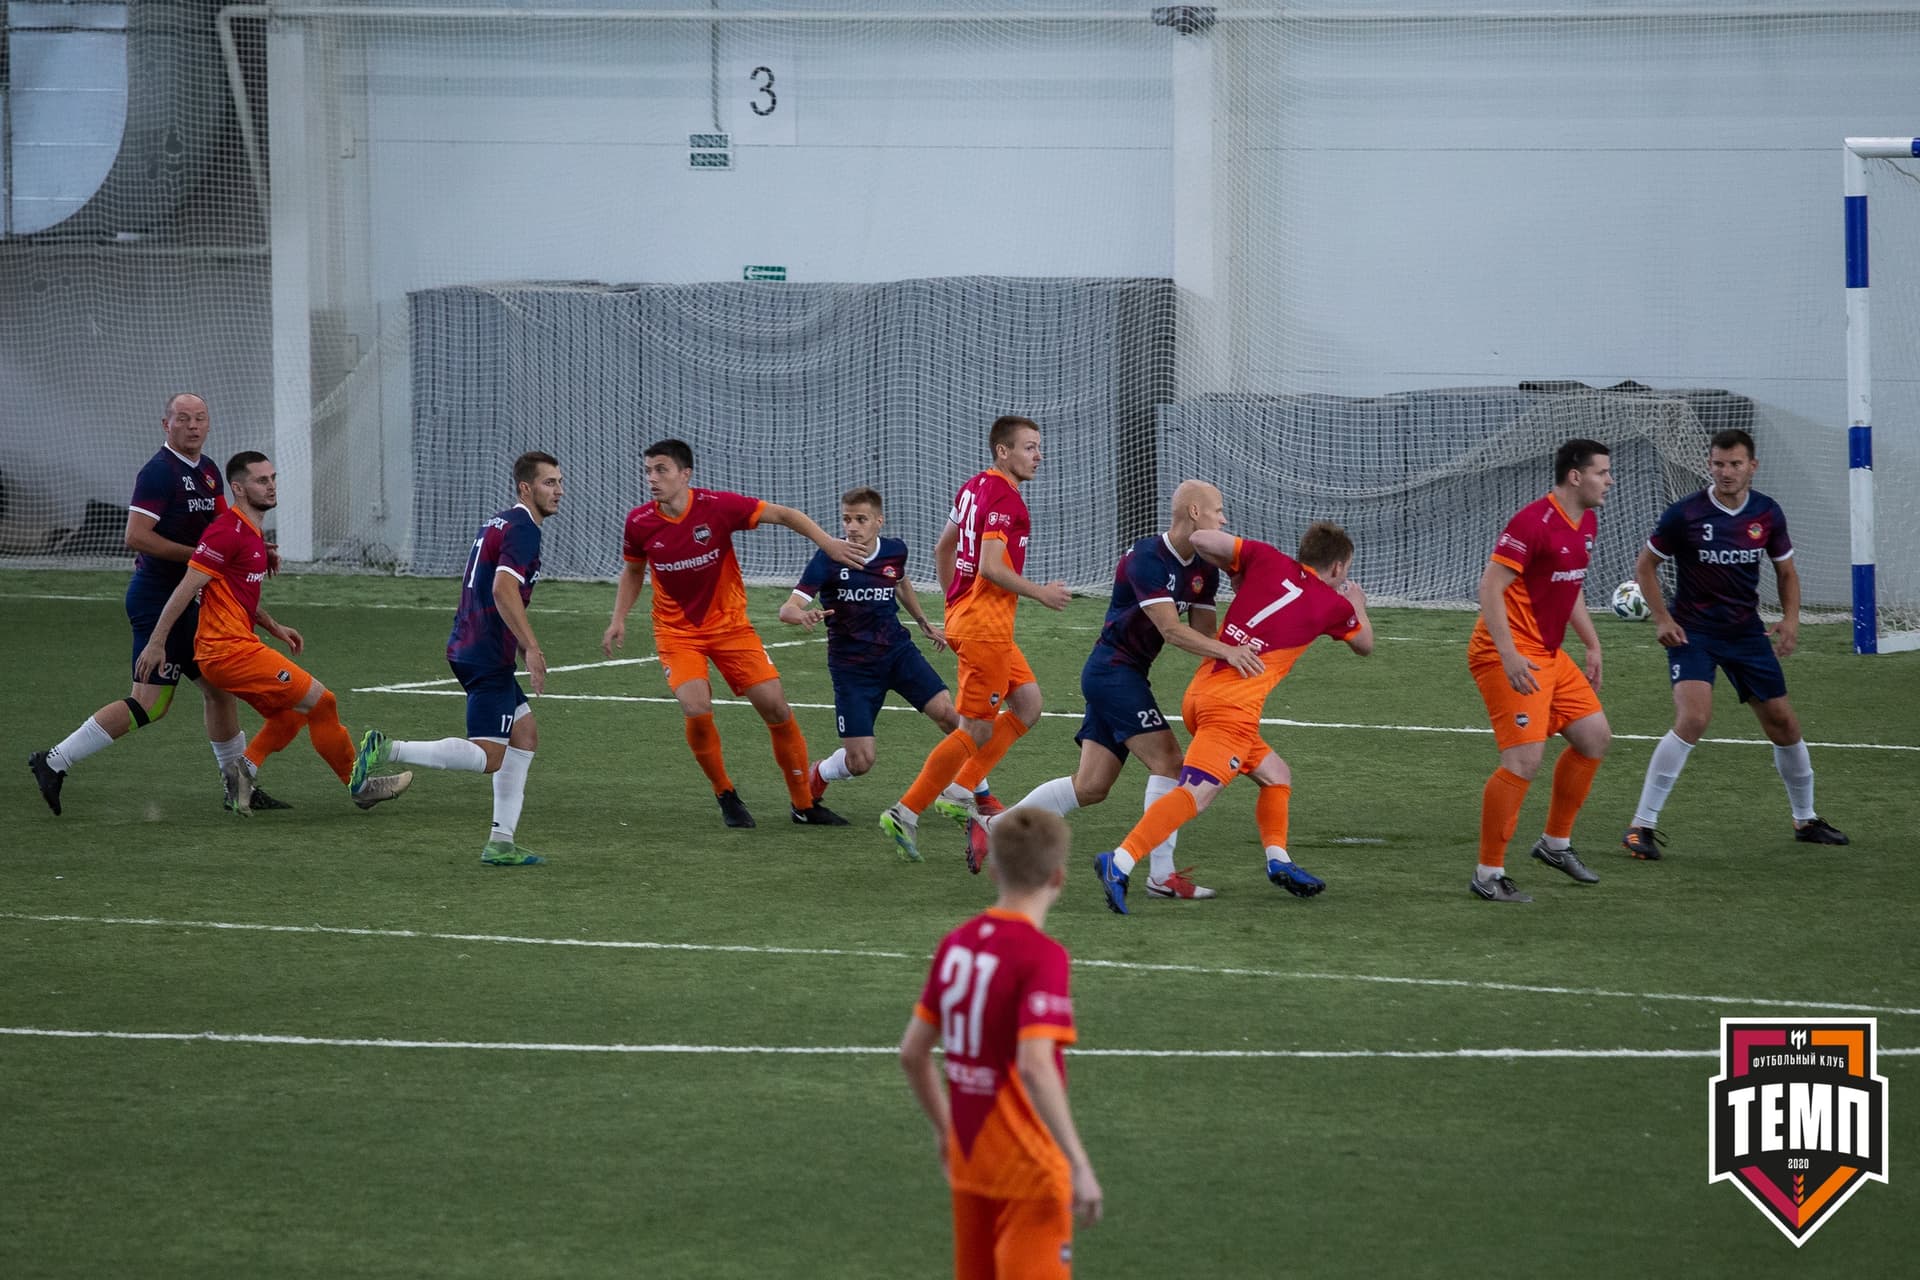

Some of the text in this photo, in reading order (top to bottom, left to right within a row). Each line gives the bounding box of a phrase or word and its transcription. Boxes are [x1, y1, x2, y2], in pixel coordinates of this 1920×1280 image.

[750, 66, 777, 116] 3
[182, 475, 195, 491] 26
[1702, 523, 1714, 541] 3
[1699, 547, 1764, 565] РАССВЕТ
[1246, 578, 1304, 629] 7
[163, 662, 181, 680] 26
[1671, 664, 1681, 680] 3
[501, 714, 513, 733] 17
[838, 715, 846, 733] 8
[1137, 708, 1163, 728] 23
[939, 945, 999, 1058] 21
